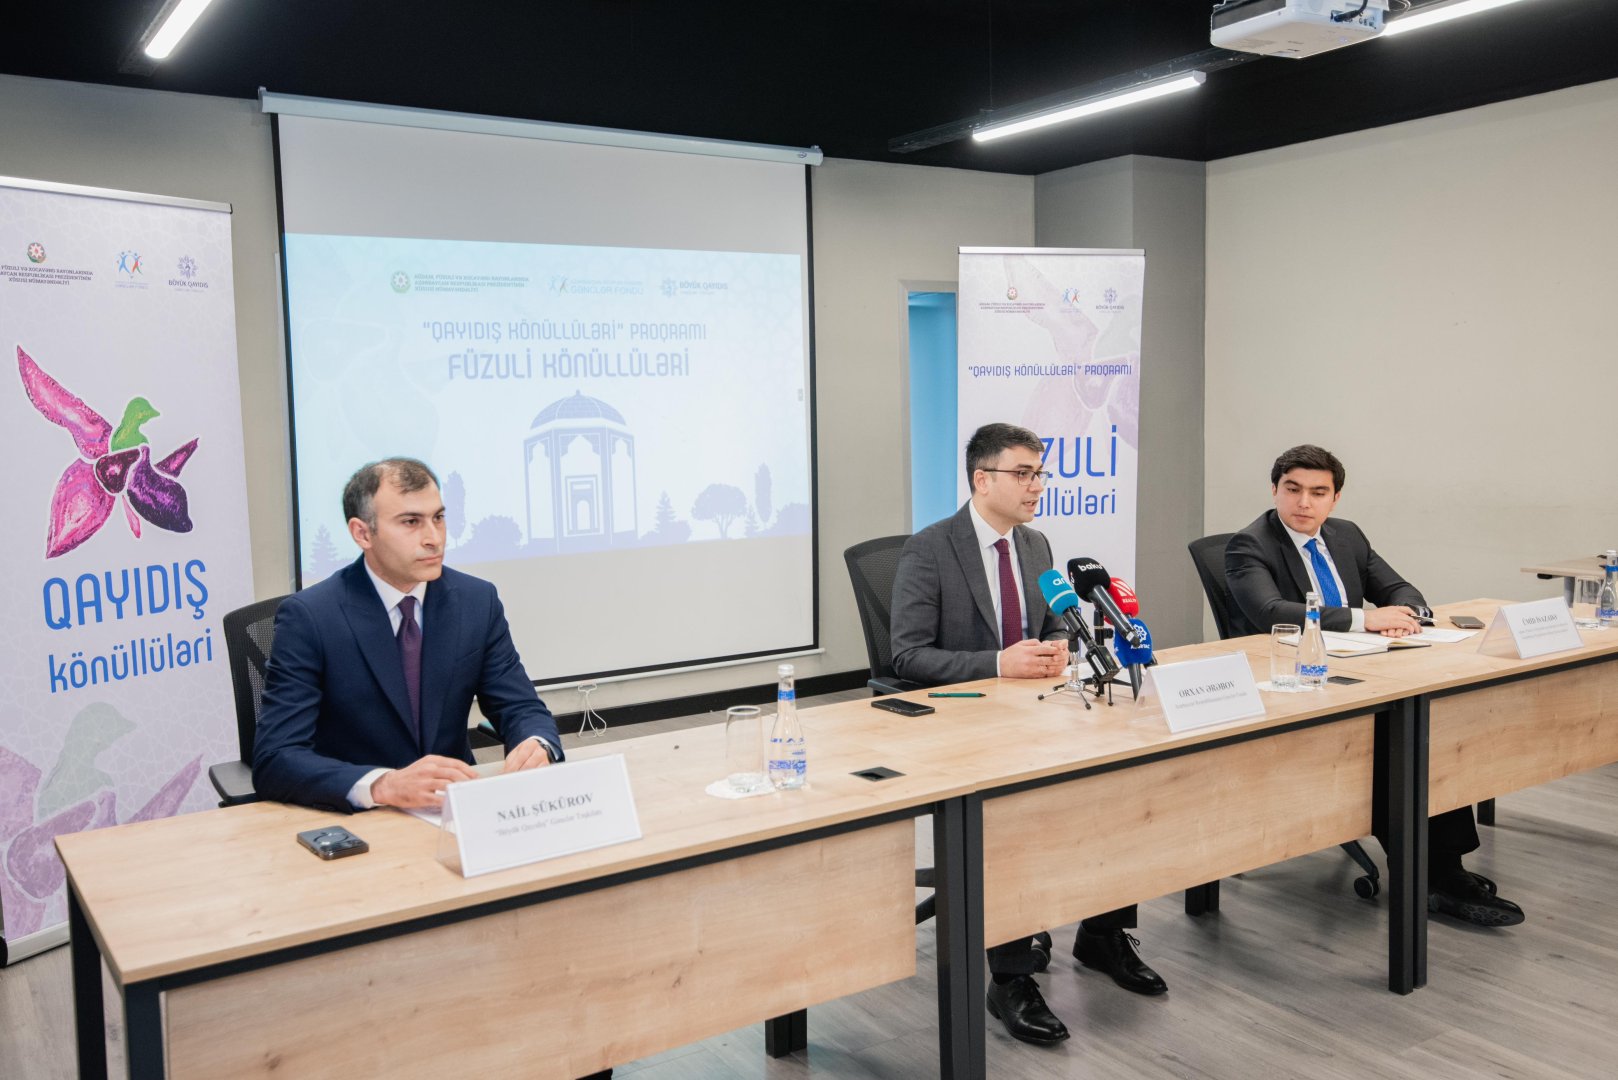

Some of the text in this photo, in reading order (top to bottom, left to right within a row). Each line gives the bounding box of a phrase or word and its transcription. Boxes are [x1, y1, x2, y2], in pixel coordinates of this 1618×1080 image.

[423, 318, 707, 344] "QAYIDIŞ KÖNÜLLÜLƏRİ" PROQRAMI
[448, 347, 690, 380] FÜZULİ KÖNÜLLÜLƏRİ
[968, 362, 1132, 378] "QAYIDIŞ KÖNÜLLÜLƏRİ" PROQRAMI
[1040, 425, 1117, 478] ZULİ
[43, 559, 209, 630] QAYIDIŞ
[48, 628, 213, 693] könüllüləri
[497, 806, 531, 823] NAİL
[531, 793, 593, 816] ŞÜKÜROV
